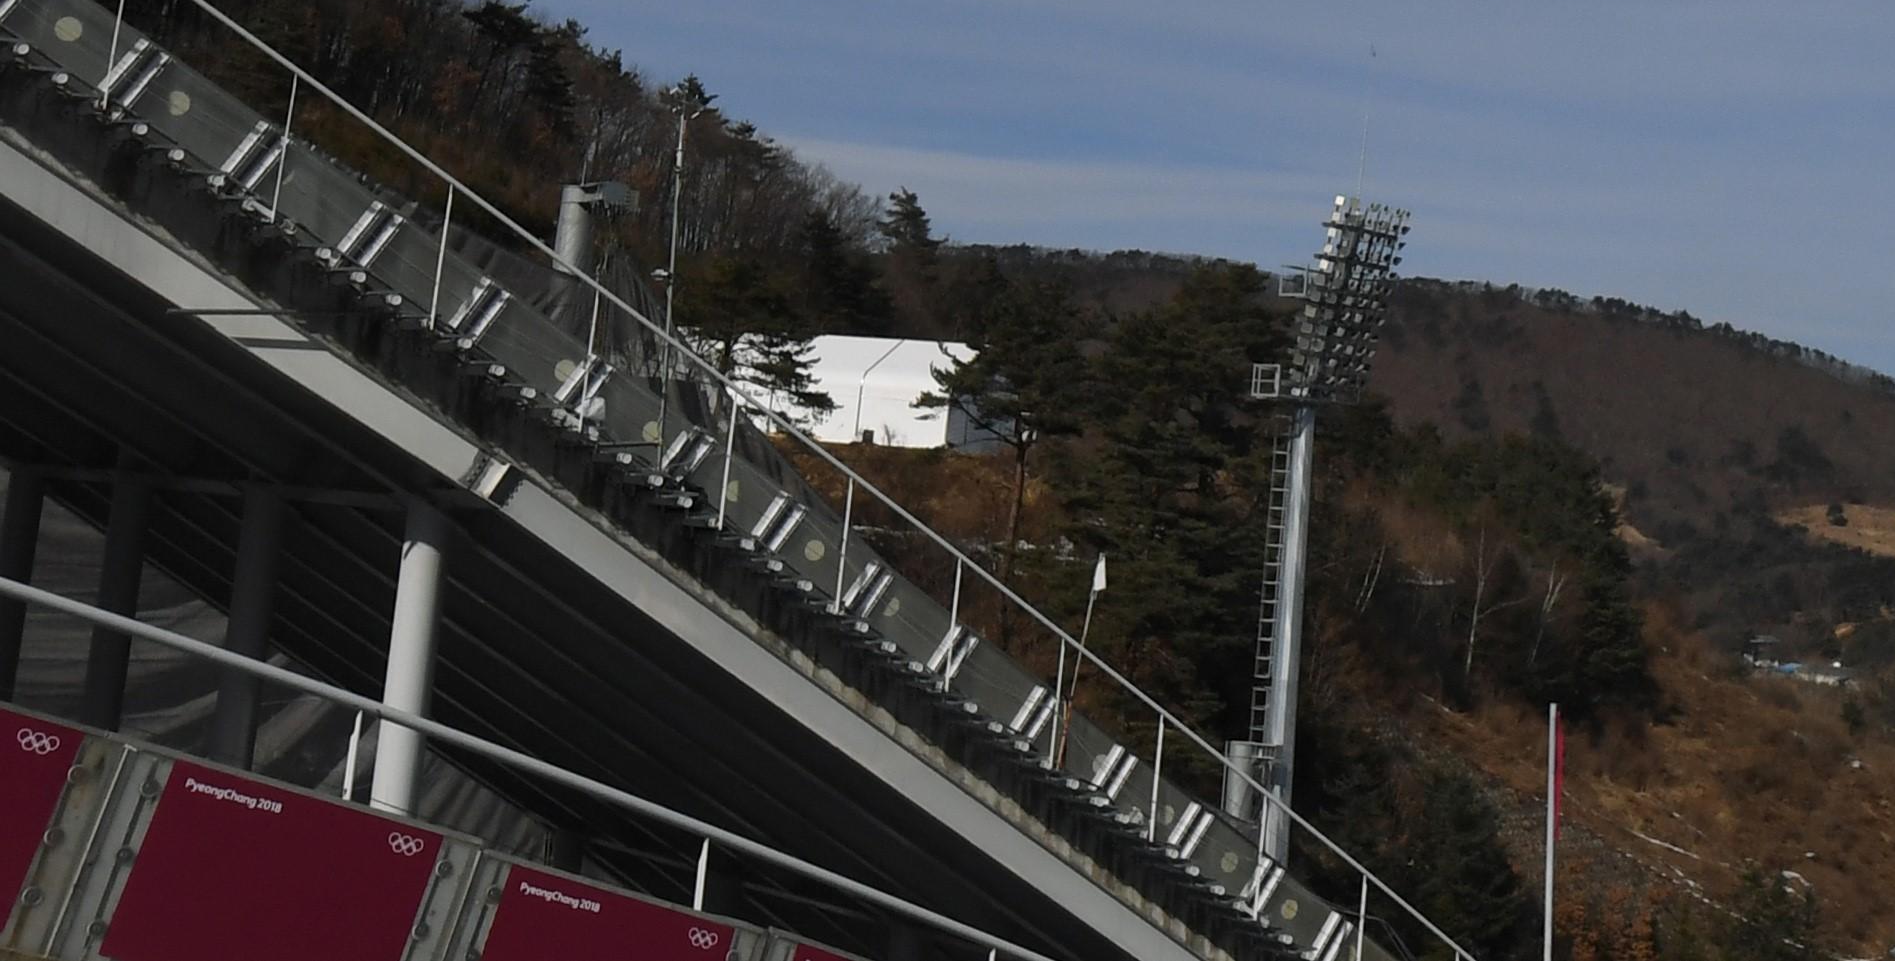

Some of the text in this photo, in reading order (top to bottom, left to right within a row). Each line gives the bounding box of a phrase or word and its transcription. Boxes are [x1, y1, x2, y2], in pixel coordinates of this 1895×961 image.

[184, 777, 283, 813] PyeongChang 2018
[519, 881, 601, 913] PyeongChang 2018
